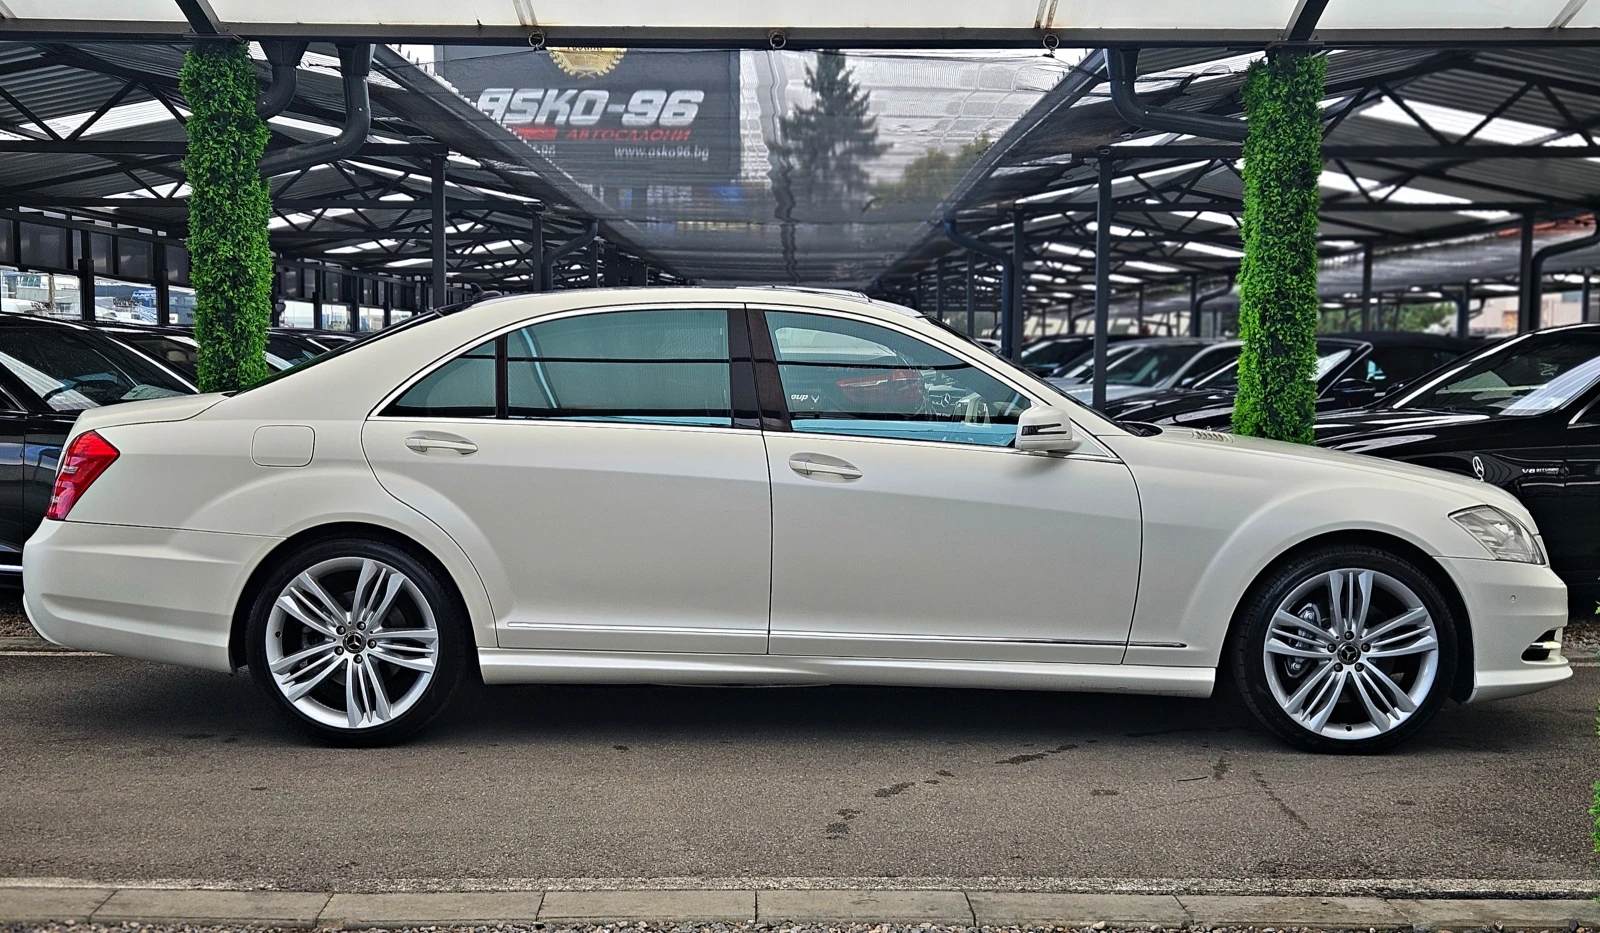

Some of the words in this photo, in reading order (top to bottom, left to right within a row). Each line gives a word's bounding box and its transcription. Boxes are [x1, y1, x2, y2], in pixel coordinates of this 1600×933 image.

[477, 88, 705, 126] ASKO-96
[565, 127, 692, 141] АВТОСАЛОНИ
[614, 145, 710, 160] www.asko96.bg
